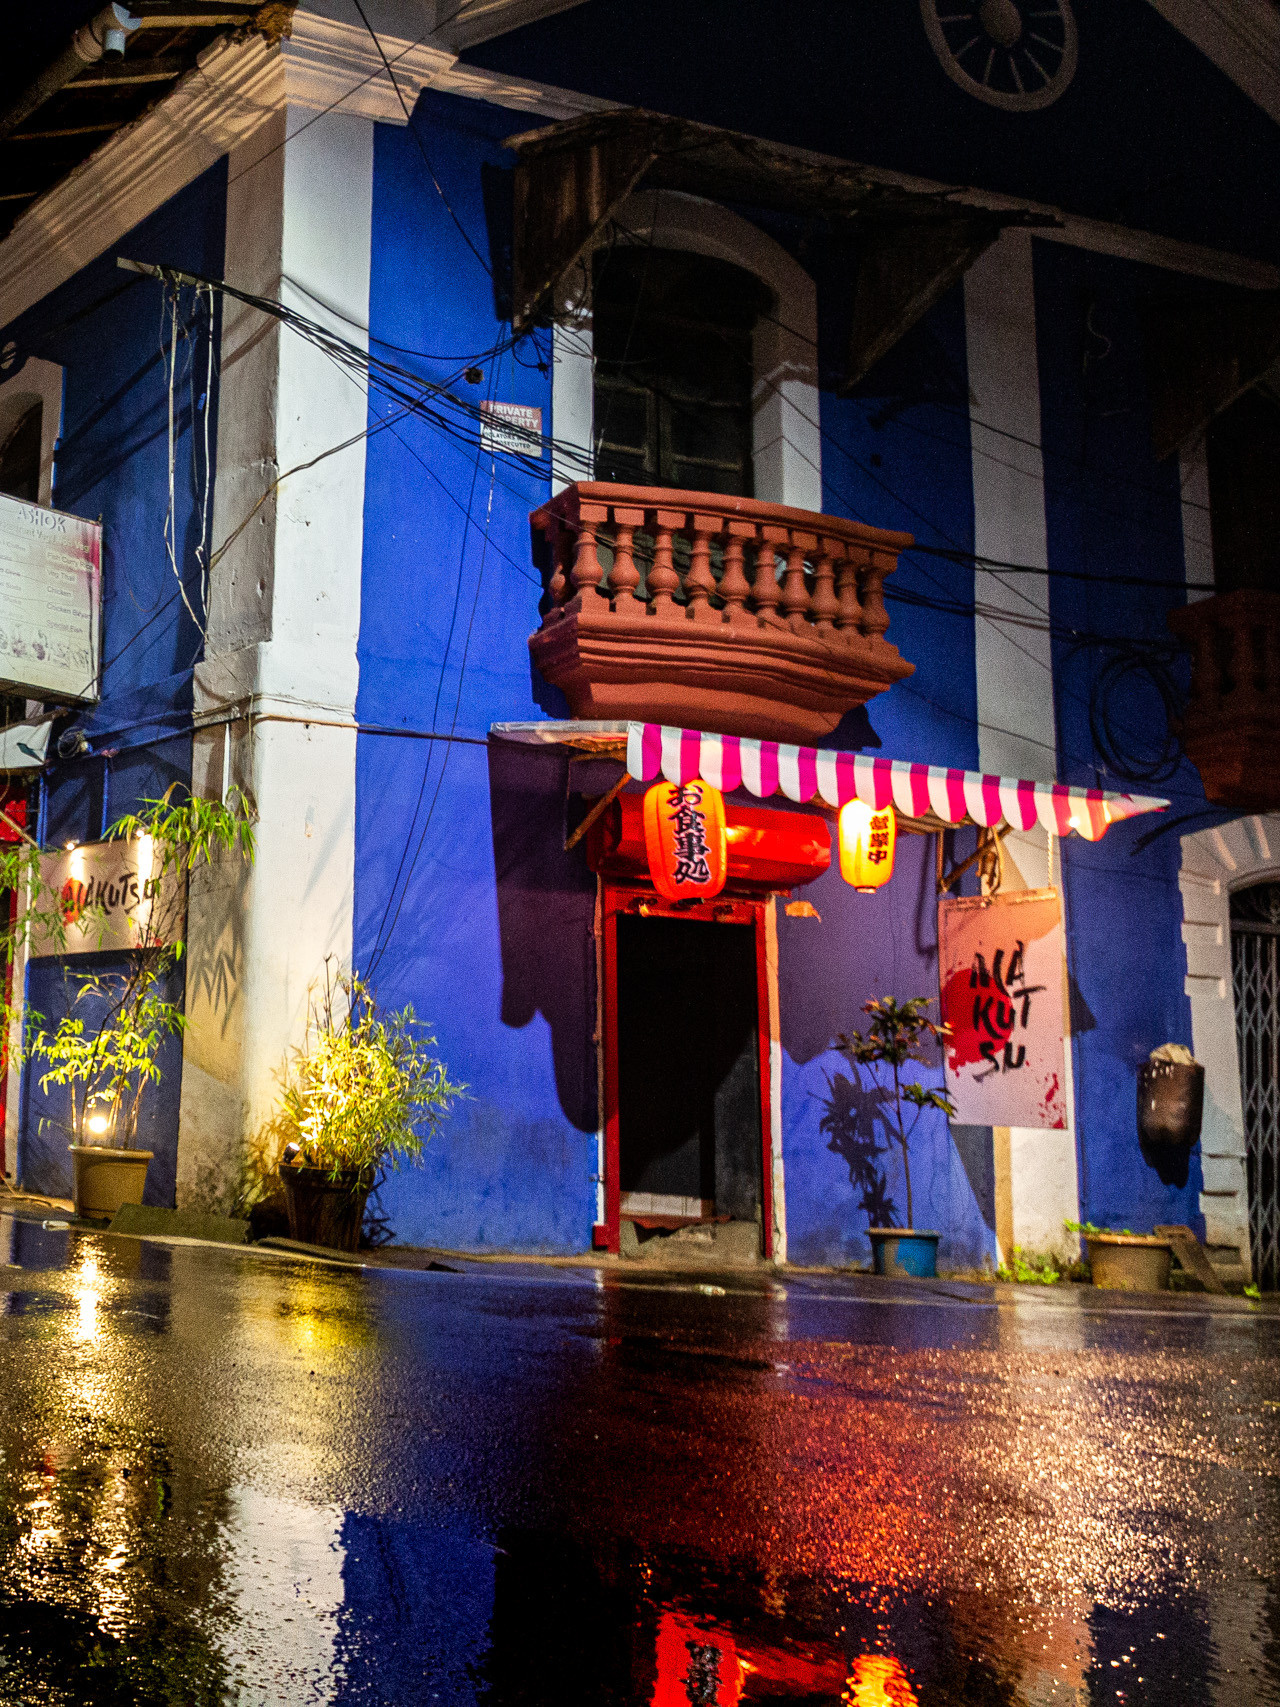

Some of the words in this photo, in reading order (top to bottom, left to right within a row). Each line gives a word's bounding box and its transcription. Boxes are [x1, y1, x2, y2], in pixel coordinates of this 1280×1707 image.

[489, 404, 533, 418] PRIVATE
[493, 414, 538, 428] OPERTY
[17, 507, 66, 533] ASHOK
[47, 585, 71, 598] Chicken
[46, 602, 71, 615] Chicken
[666, 785, 711, 884] お食事処
[972, 1041, 1026, 1083] SU
